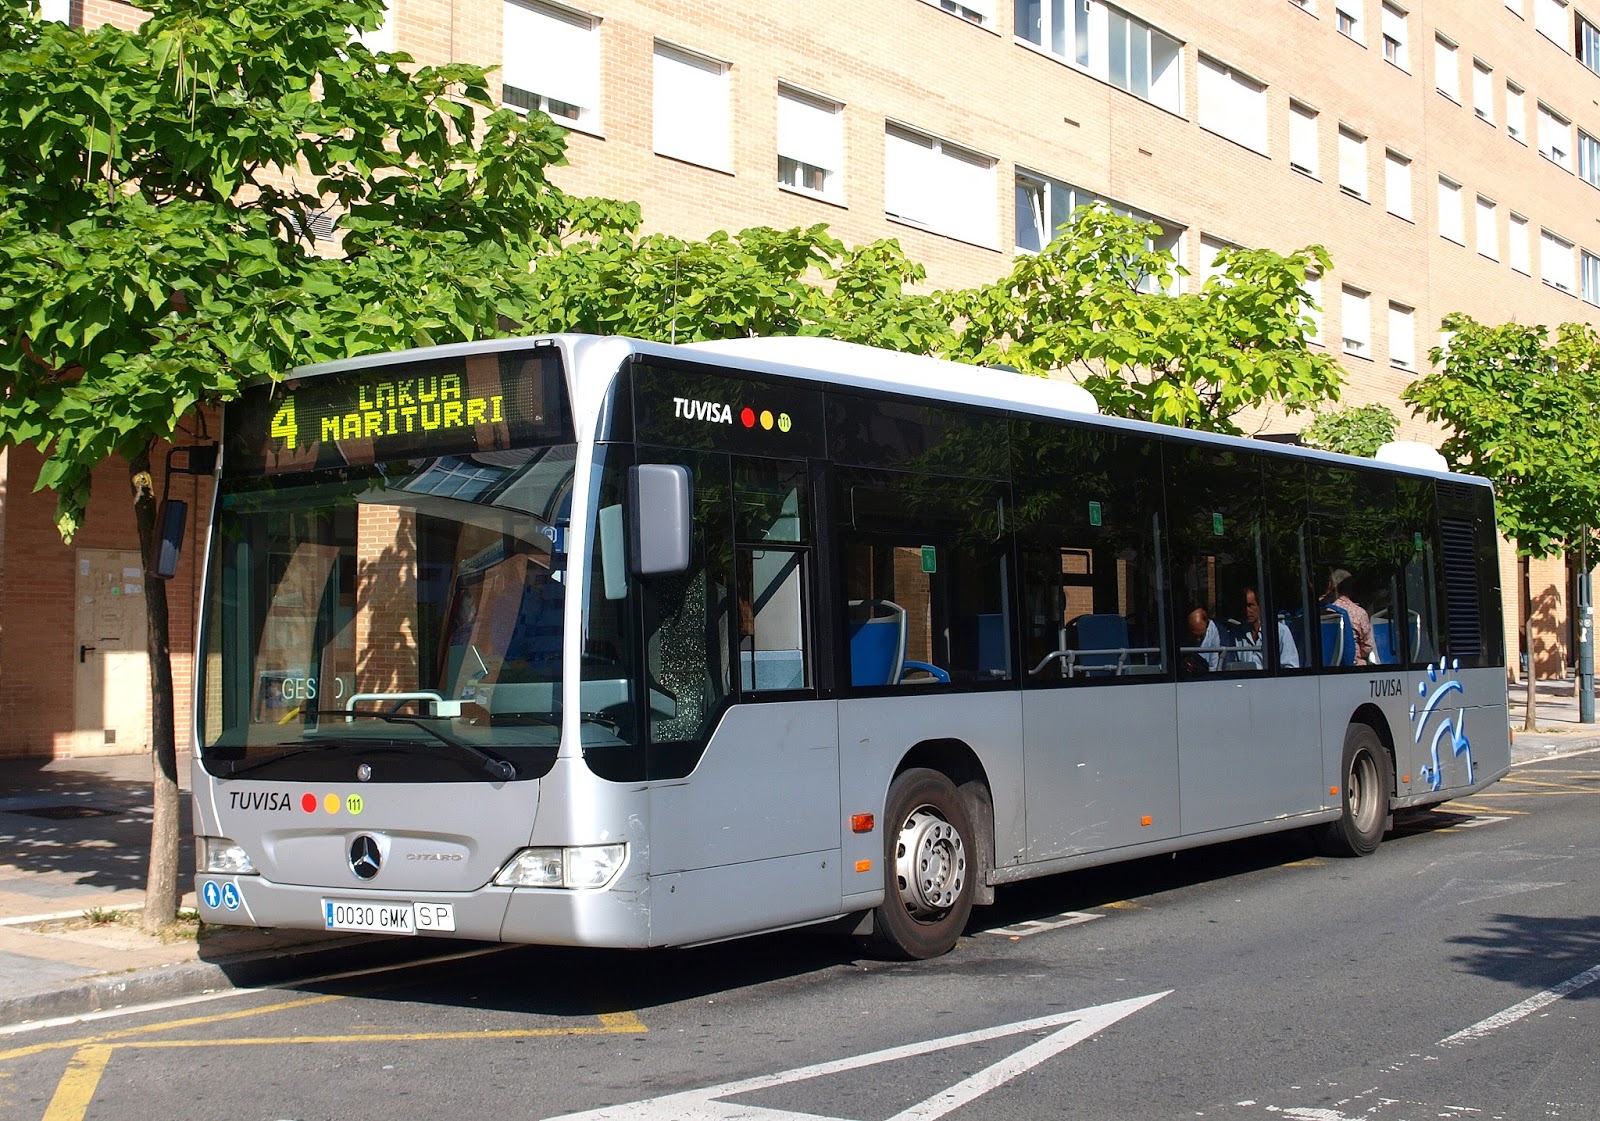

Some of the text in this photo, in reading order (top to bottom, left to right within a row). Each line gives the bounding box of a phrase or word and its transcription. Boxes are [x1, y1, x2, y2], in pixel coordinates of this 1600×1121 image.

[359, 373, 461, 411] LAKUA
[271, 395, 298, 450] 4
[321, 395, 503, 443] MARITURRI
[673, 397, 733, 425] TUVISA
[1369, 678, 1403, 698] TUVISA
[229, 791, 361, 811] TUVISA 111
[406, 852, 464, 862] CITARO
[336, 905, 448, 929] 0030 GMK SP
